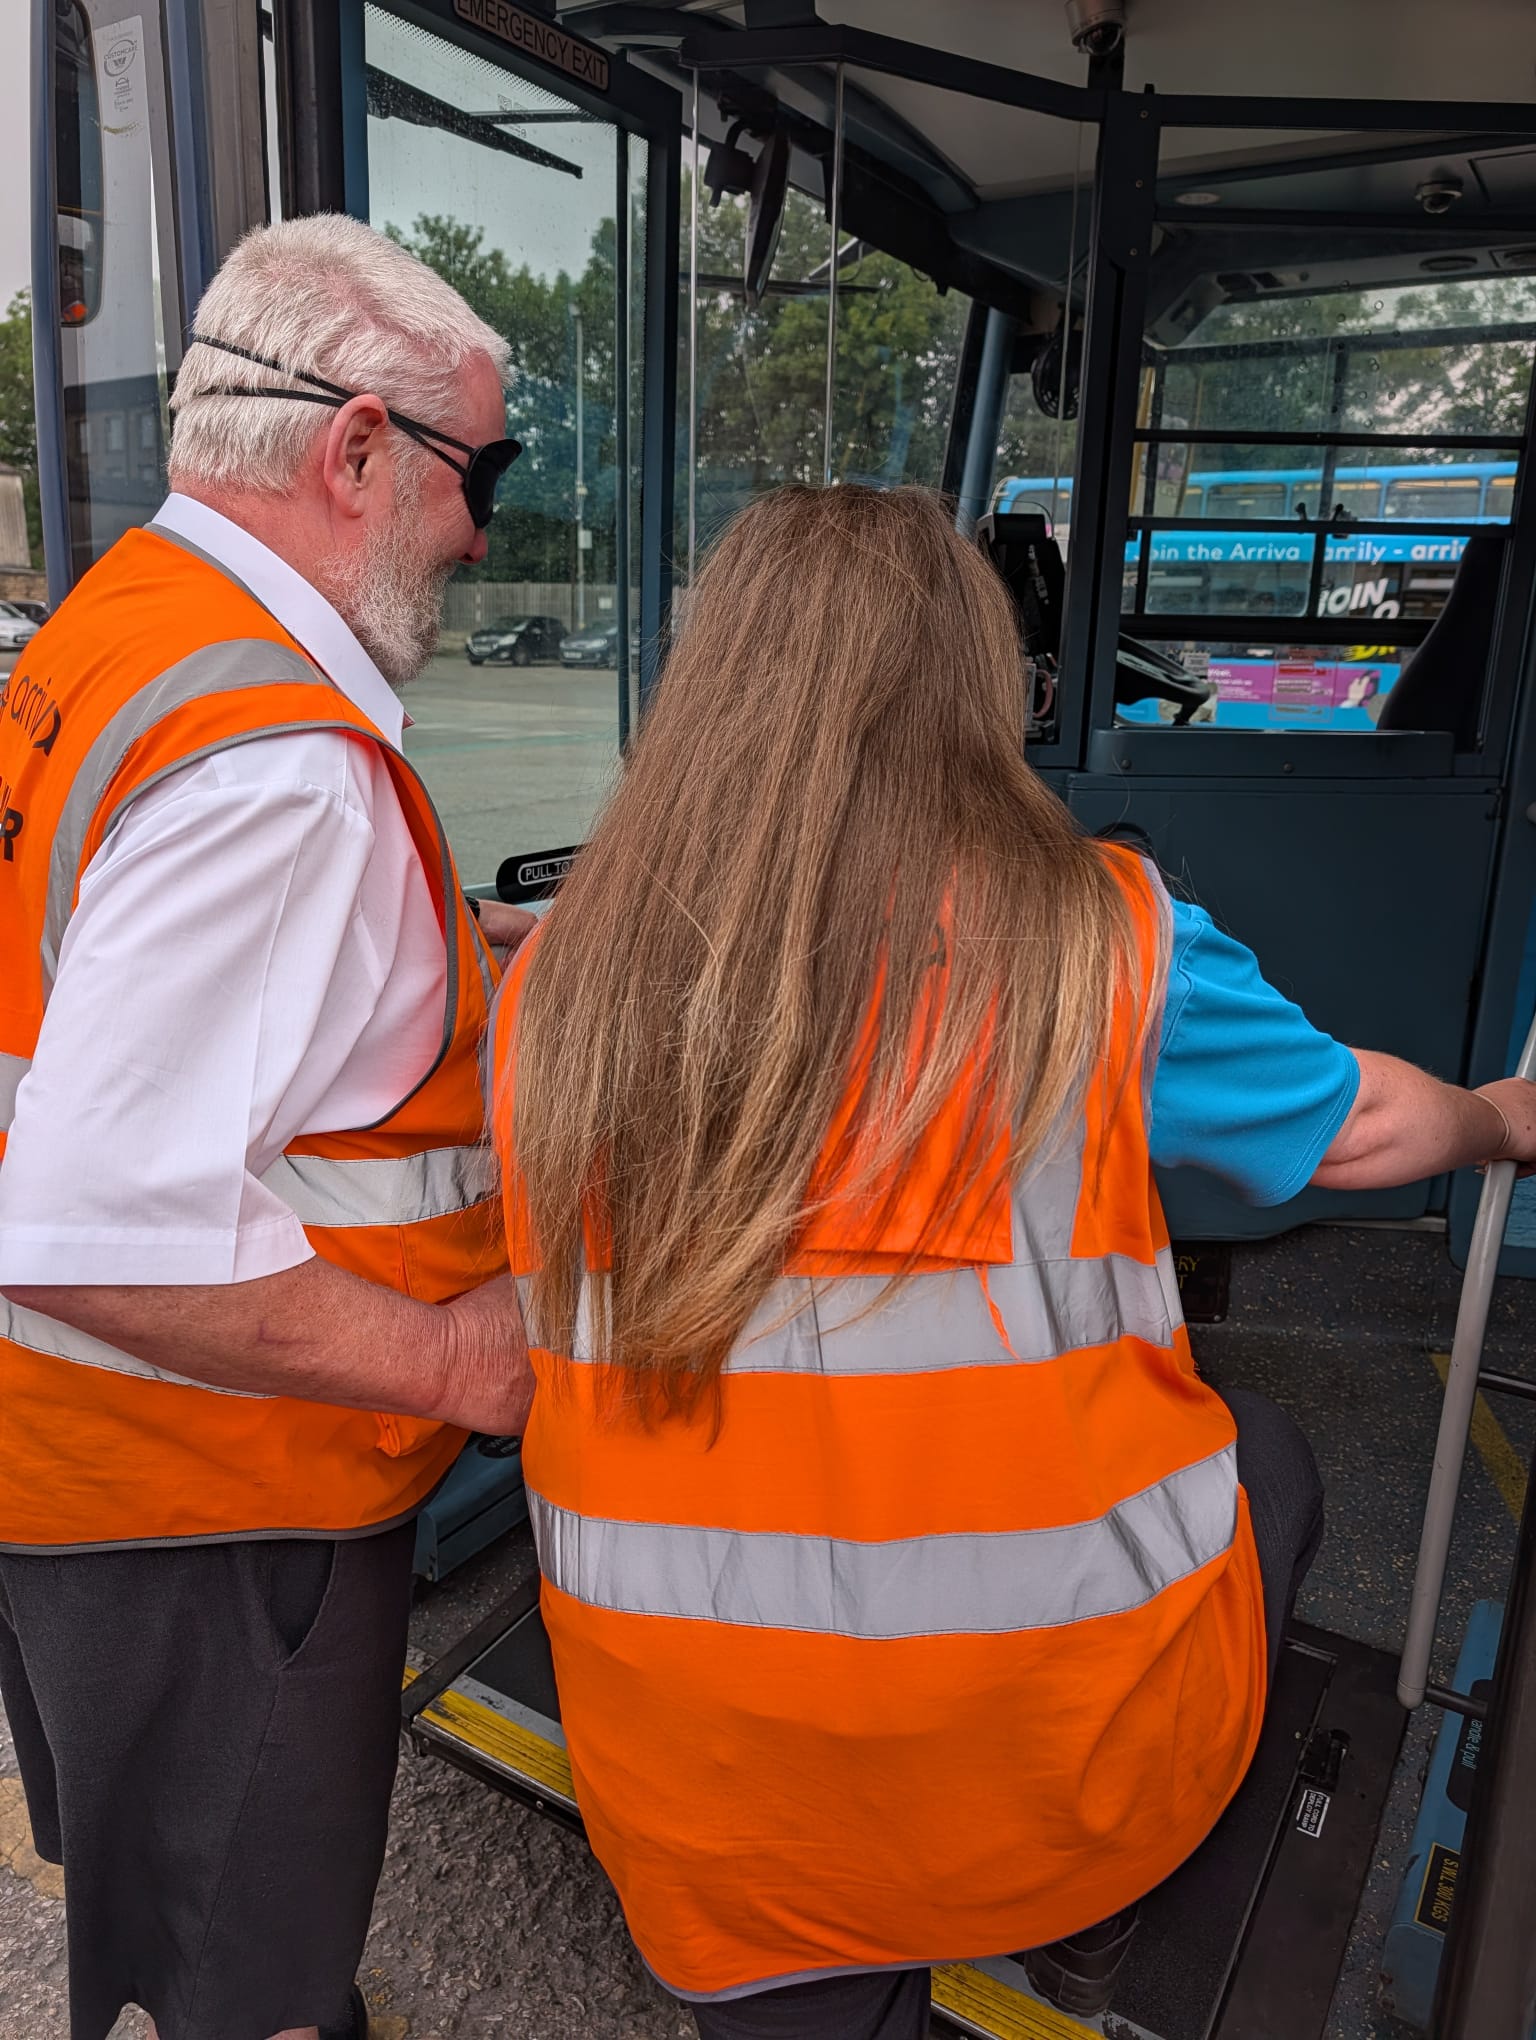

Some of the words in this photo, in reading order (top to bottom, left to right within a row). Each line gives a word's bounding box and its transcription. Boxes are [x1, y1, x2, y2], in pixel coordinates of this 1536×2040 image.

[457, 0, 568, 65] EMERGENCY
[573, 46, 607, 85] EXIT
[1188, 544, 1224, 561] the
[1229, 542, 1301, 561] Arriva
[525, 867, 553, 881] PULL
[554, 861, 571, 875] TO
[1466, 1718, 1483, 1744] andle
[1308, 1824, 1316, 1832] TO
[1431, 1899, 1450, 1922] KGS
